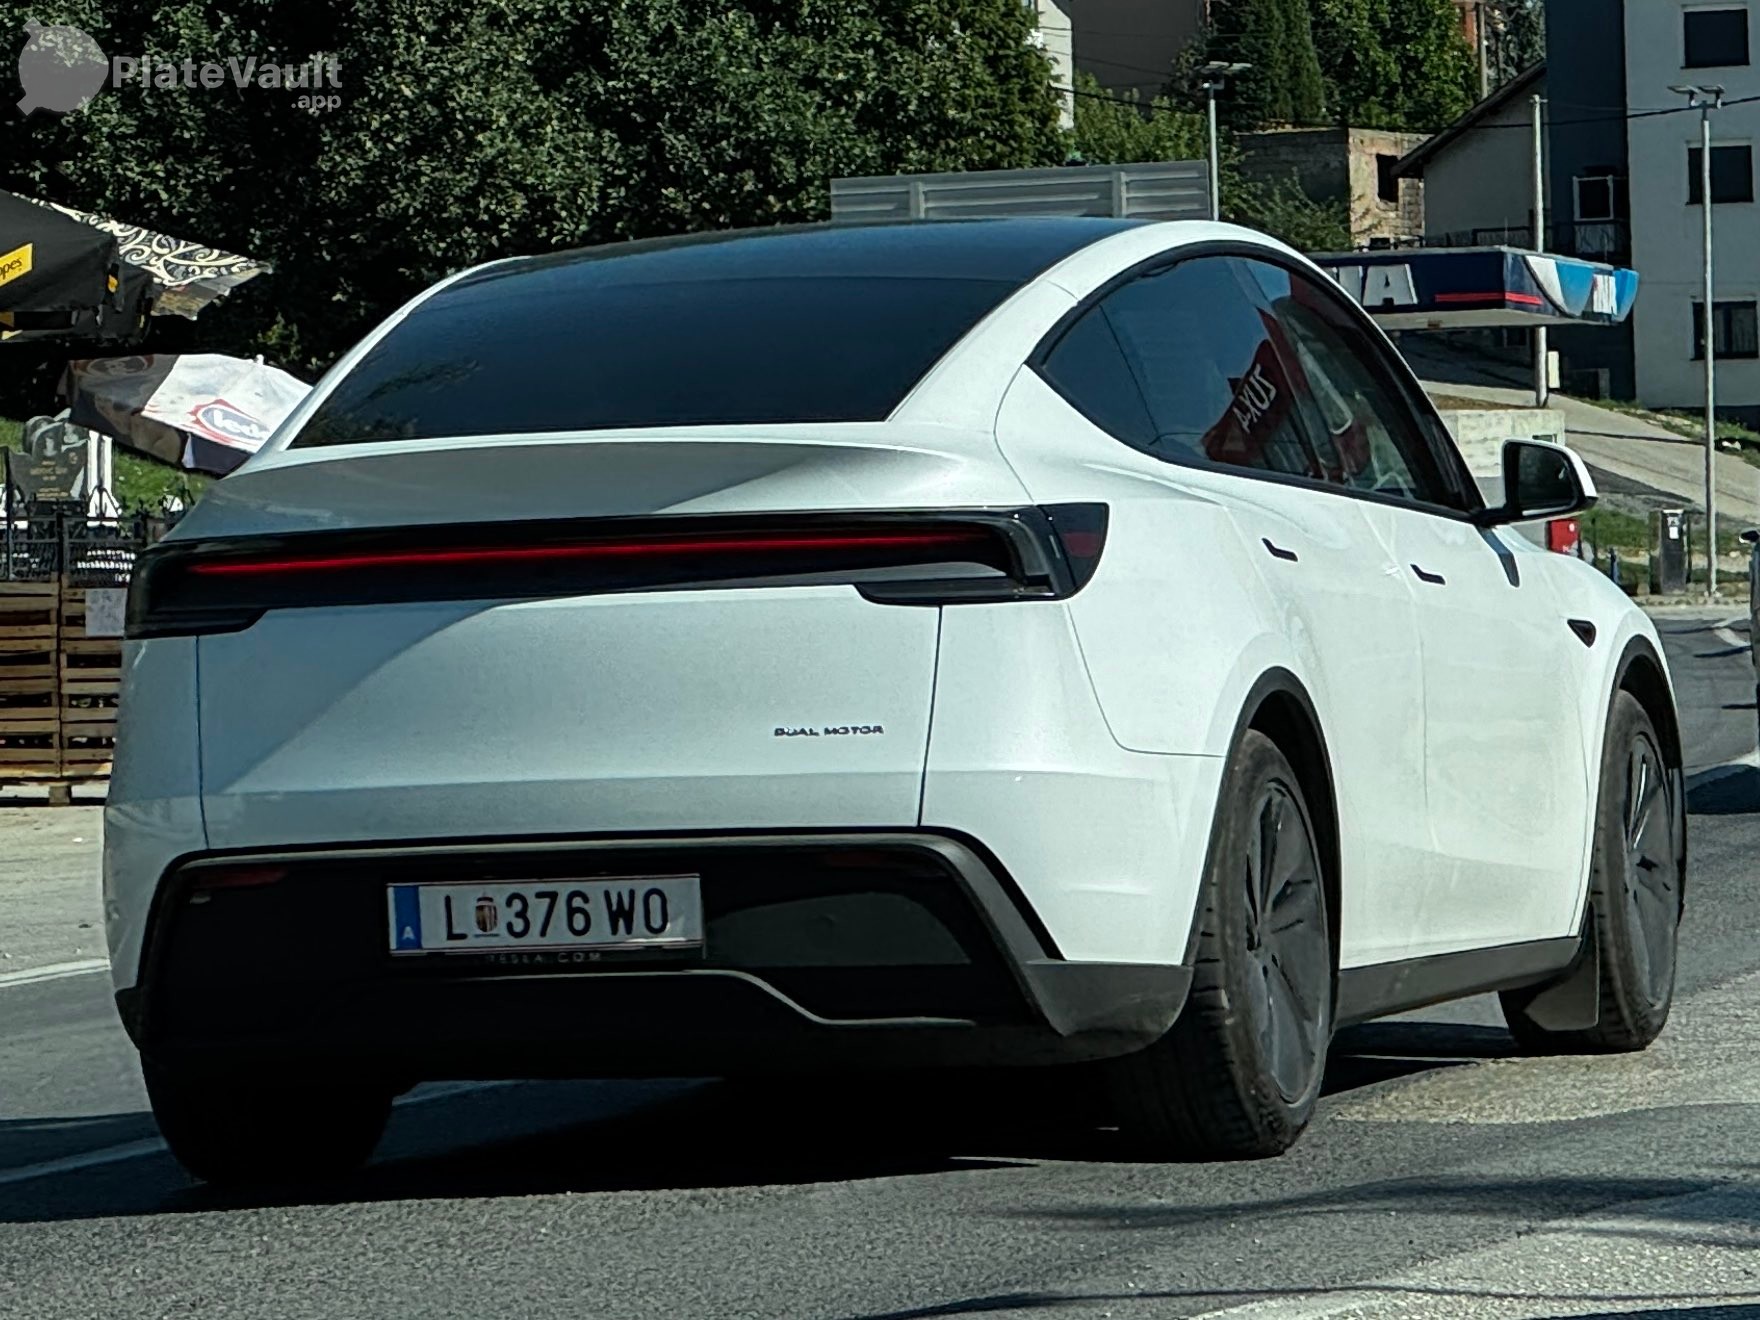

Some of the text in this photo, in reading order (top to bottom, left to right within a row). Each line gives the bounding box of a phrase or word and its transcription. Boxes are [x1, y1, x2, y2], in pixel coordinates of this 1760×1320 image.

[774, 725, 884, 737] DUAL MOTOR
[445, 895, 468, 942] L
[505, 890, 592, 939] 376
[401, 926, 416, 940] A
